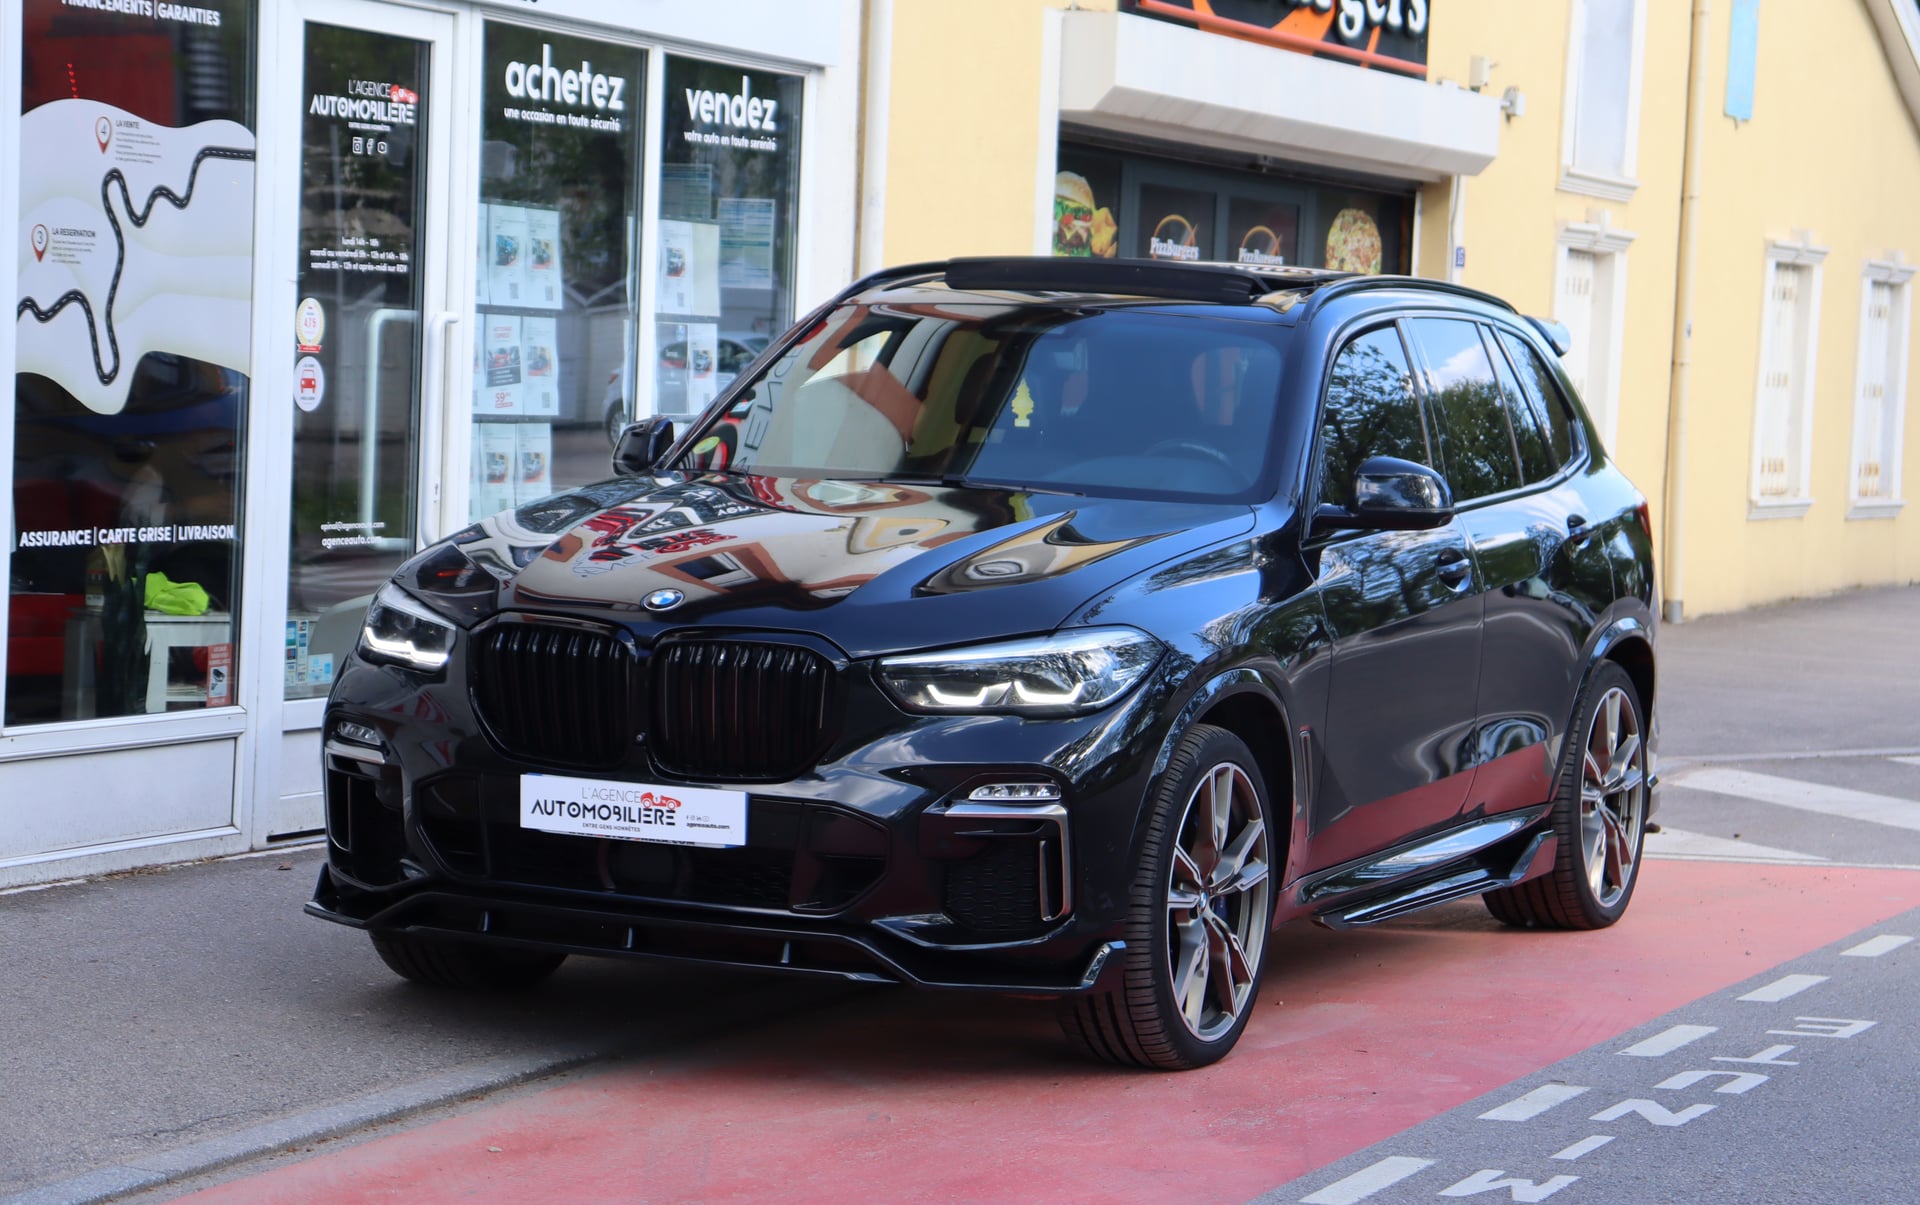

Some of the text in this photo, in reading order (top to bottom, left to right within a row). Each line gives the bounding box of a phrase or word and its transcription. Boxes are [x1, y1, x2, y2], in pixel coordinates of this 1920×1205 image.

[157, 3, 220, 26] GARANTIES
[505, 43, 626, 111] achetez
[348, 79, 391, 98] L'AGENCE
[685, 75, 777, 131] vendez
[504, 107, 620, 132] une occasion en toute sécurité
[684, 130, 702, 142] votre
[703, 132, 719, 144] auto
[721, 136, 730, 145] en
[731, 134, 749, 148] toute
[19, 525, 234, 547] ASSURANCE CARTE GRISE LIVRAISON
[321, 534, 383, 549] agenceauto.com
[581, 787, 640, 803] L'AGENCE
